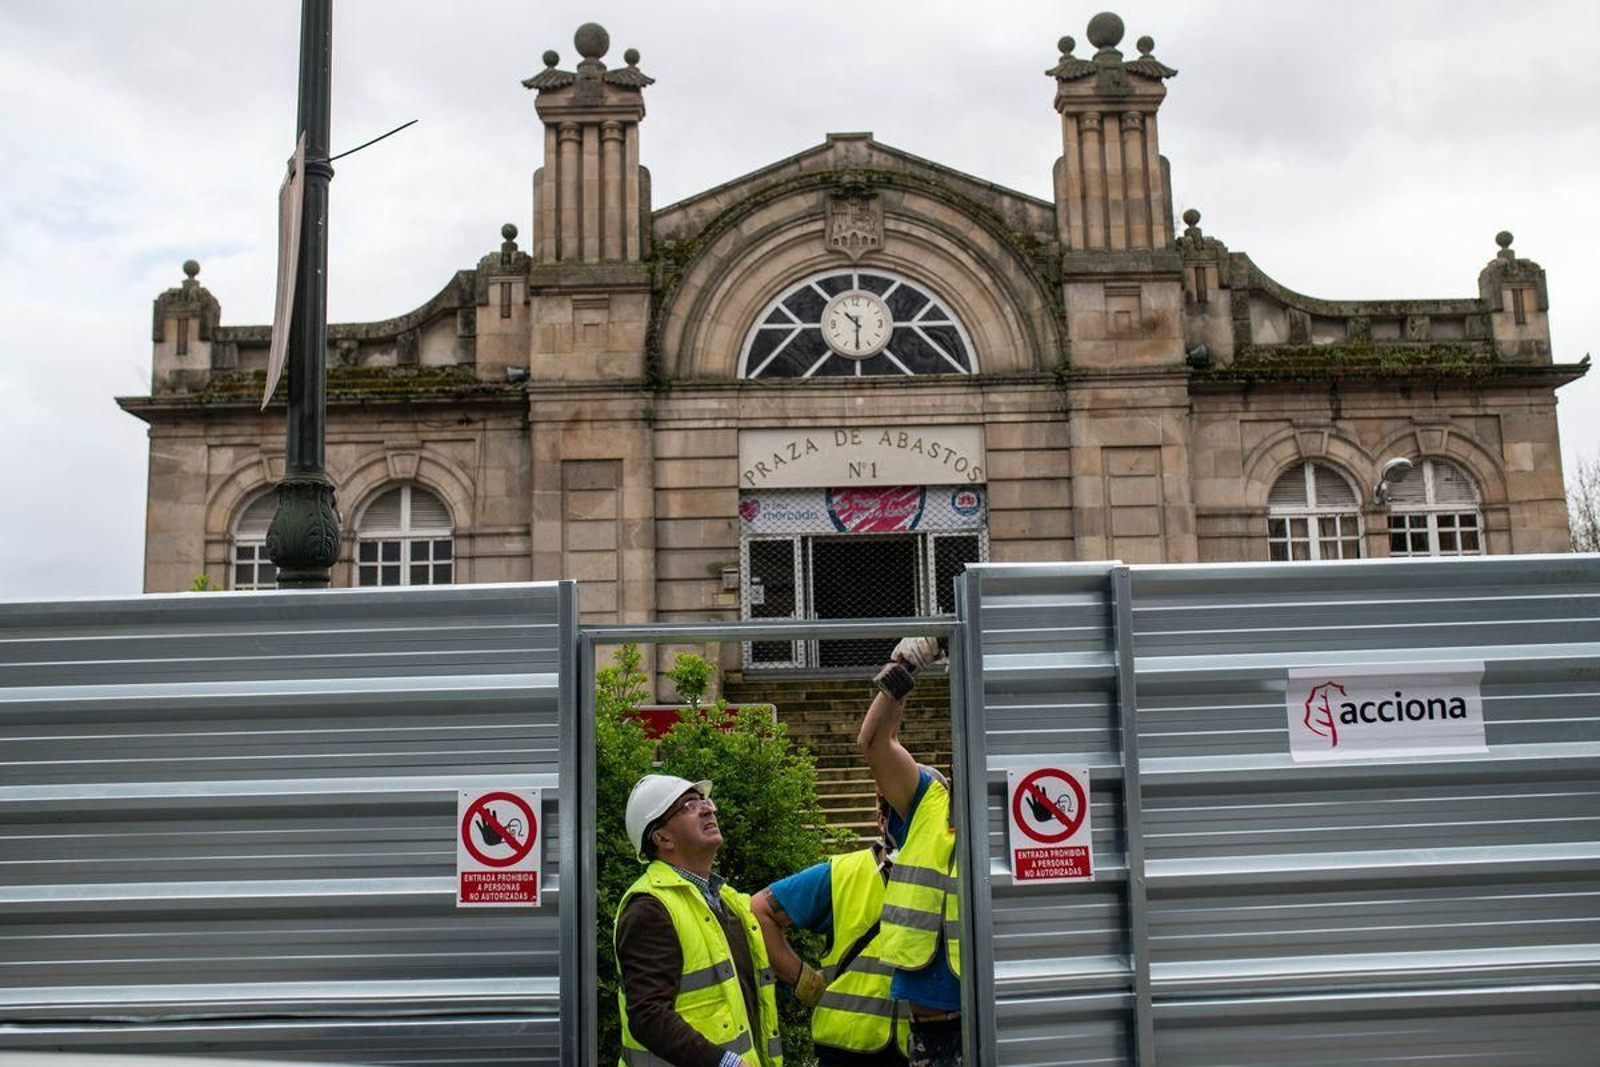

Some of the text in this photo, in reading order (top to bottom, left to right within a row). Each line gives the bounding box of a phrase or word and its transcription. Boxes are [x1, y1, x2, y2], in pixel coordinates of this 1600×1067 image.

[743, 428, 983, 486] PRAZA DE ABASTOS
[1339, 691, 1467, 725] acciona
[1018, 849, 1086, 859] ENTRADA PROHIBIDA
[1037, 858, 1074, 868] PERSONAS
[1036, 867, 1082, 877] AUTORIZADAS
[464, 874, 534, 882] ENTRADA PROHIBIDA
[477, 883, 520, 891] A PERSONAS
[469, 892, 528, 900] NO AUTORIZADAS
